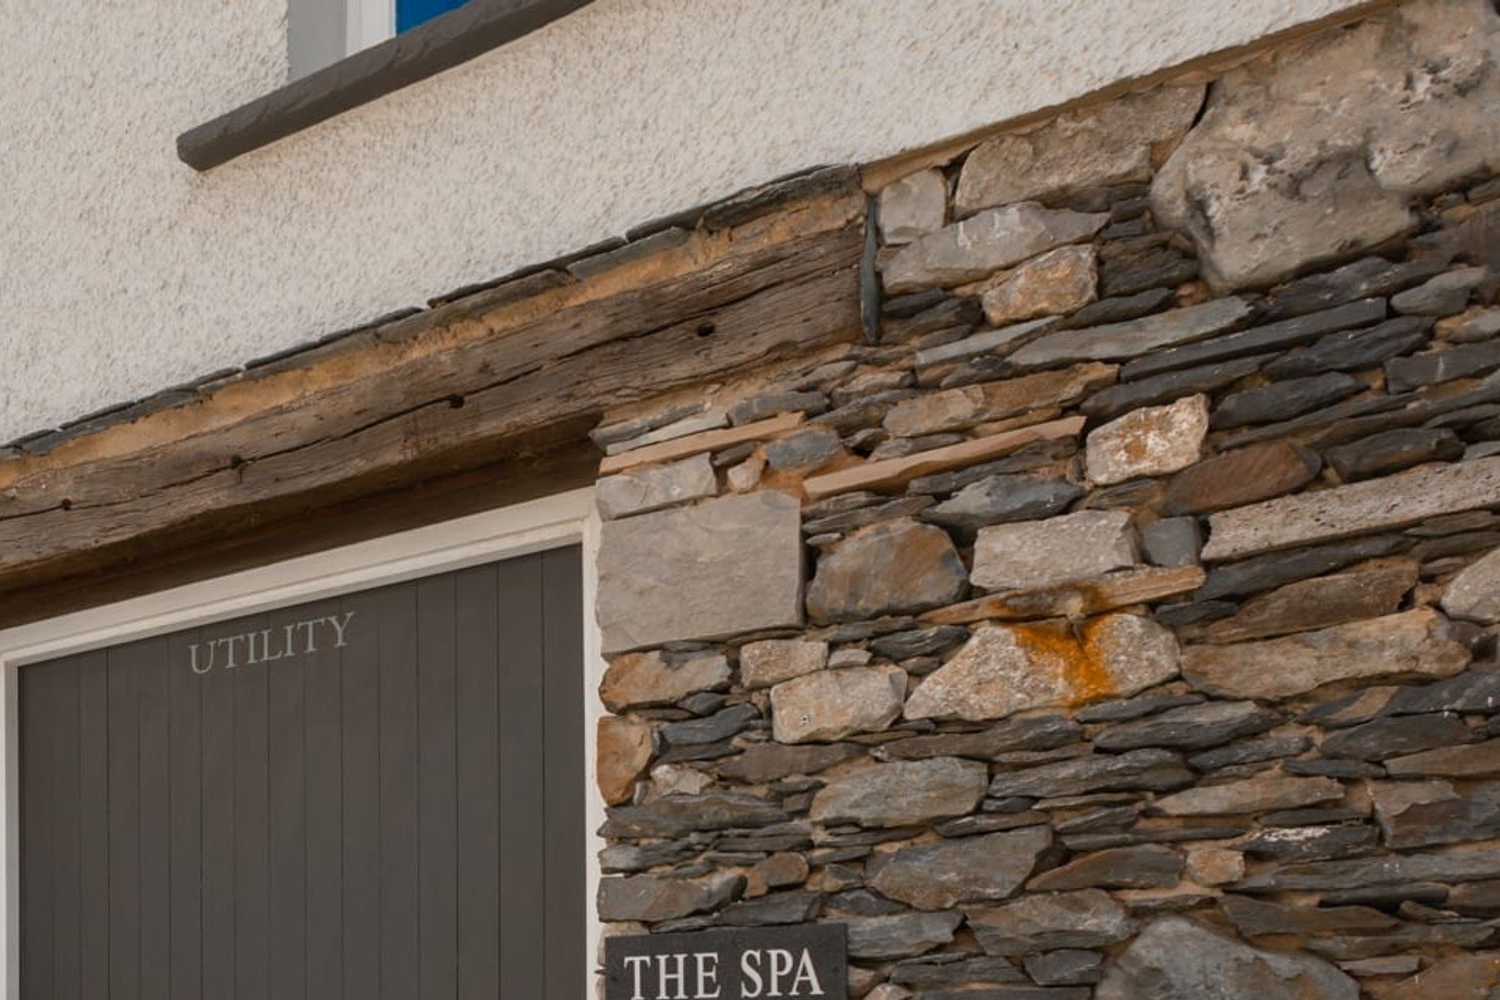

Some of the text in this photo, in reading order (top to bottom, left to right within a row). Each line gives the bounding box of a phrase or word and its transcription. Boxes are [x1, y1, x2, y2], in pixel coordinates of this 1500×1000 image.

[188, 611, 356, 674] UTILITY
[623, 947, 825, 1000] THE SPA
